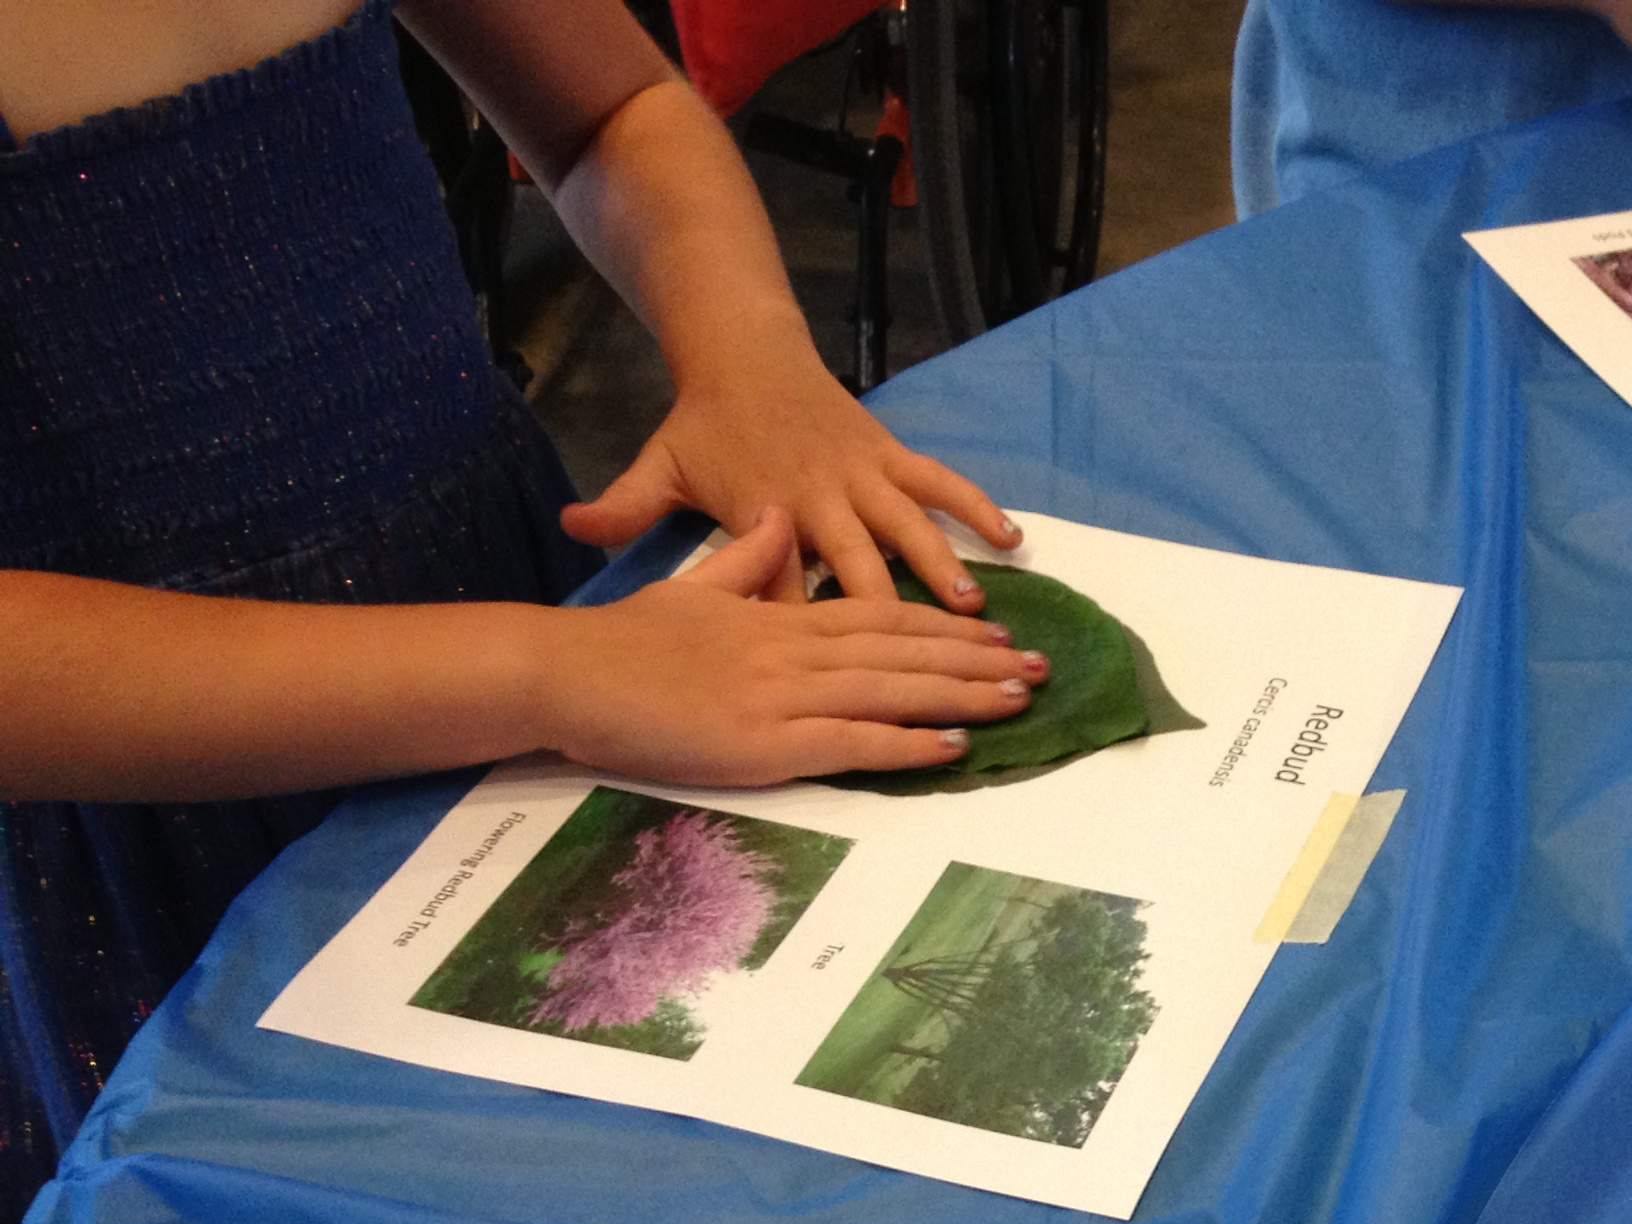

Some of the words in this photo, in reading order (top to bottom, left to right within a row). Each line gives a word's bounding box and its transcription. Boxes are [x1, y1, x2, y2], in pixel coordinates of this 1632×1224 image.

[1252, 676, 1288, 716] Cercis
[1208, 716, 1261, 789] canadensis
[1274, 703, 1345, 787] Redbud
[459, 810, 527, 869] Flowering
[420, 869, 474, 919] Redbud
[392, 920, 432, 948] Tree
[810, 943, 846, 971] Tree
